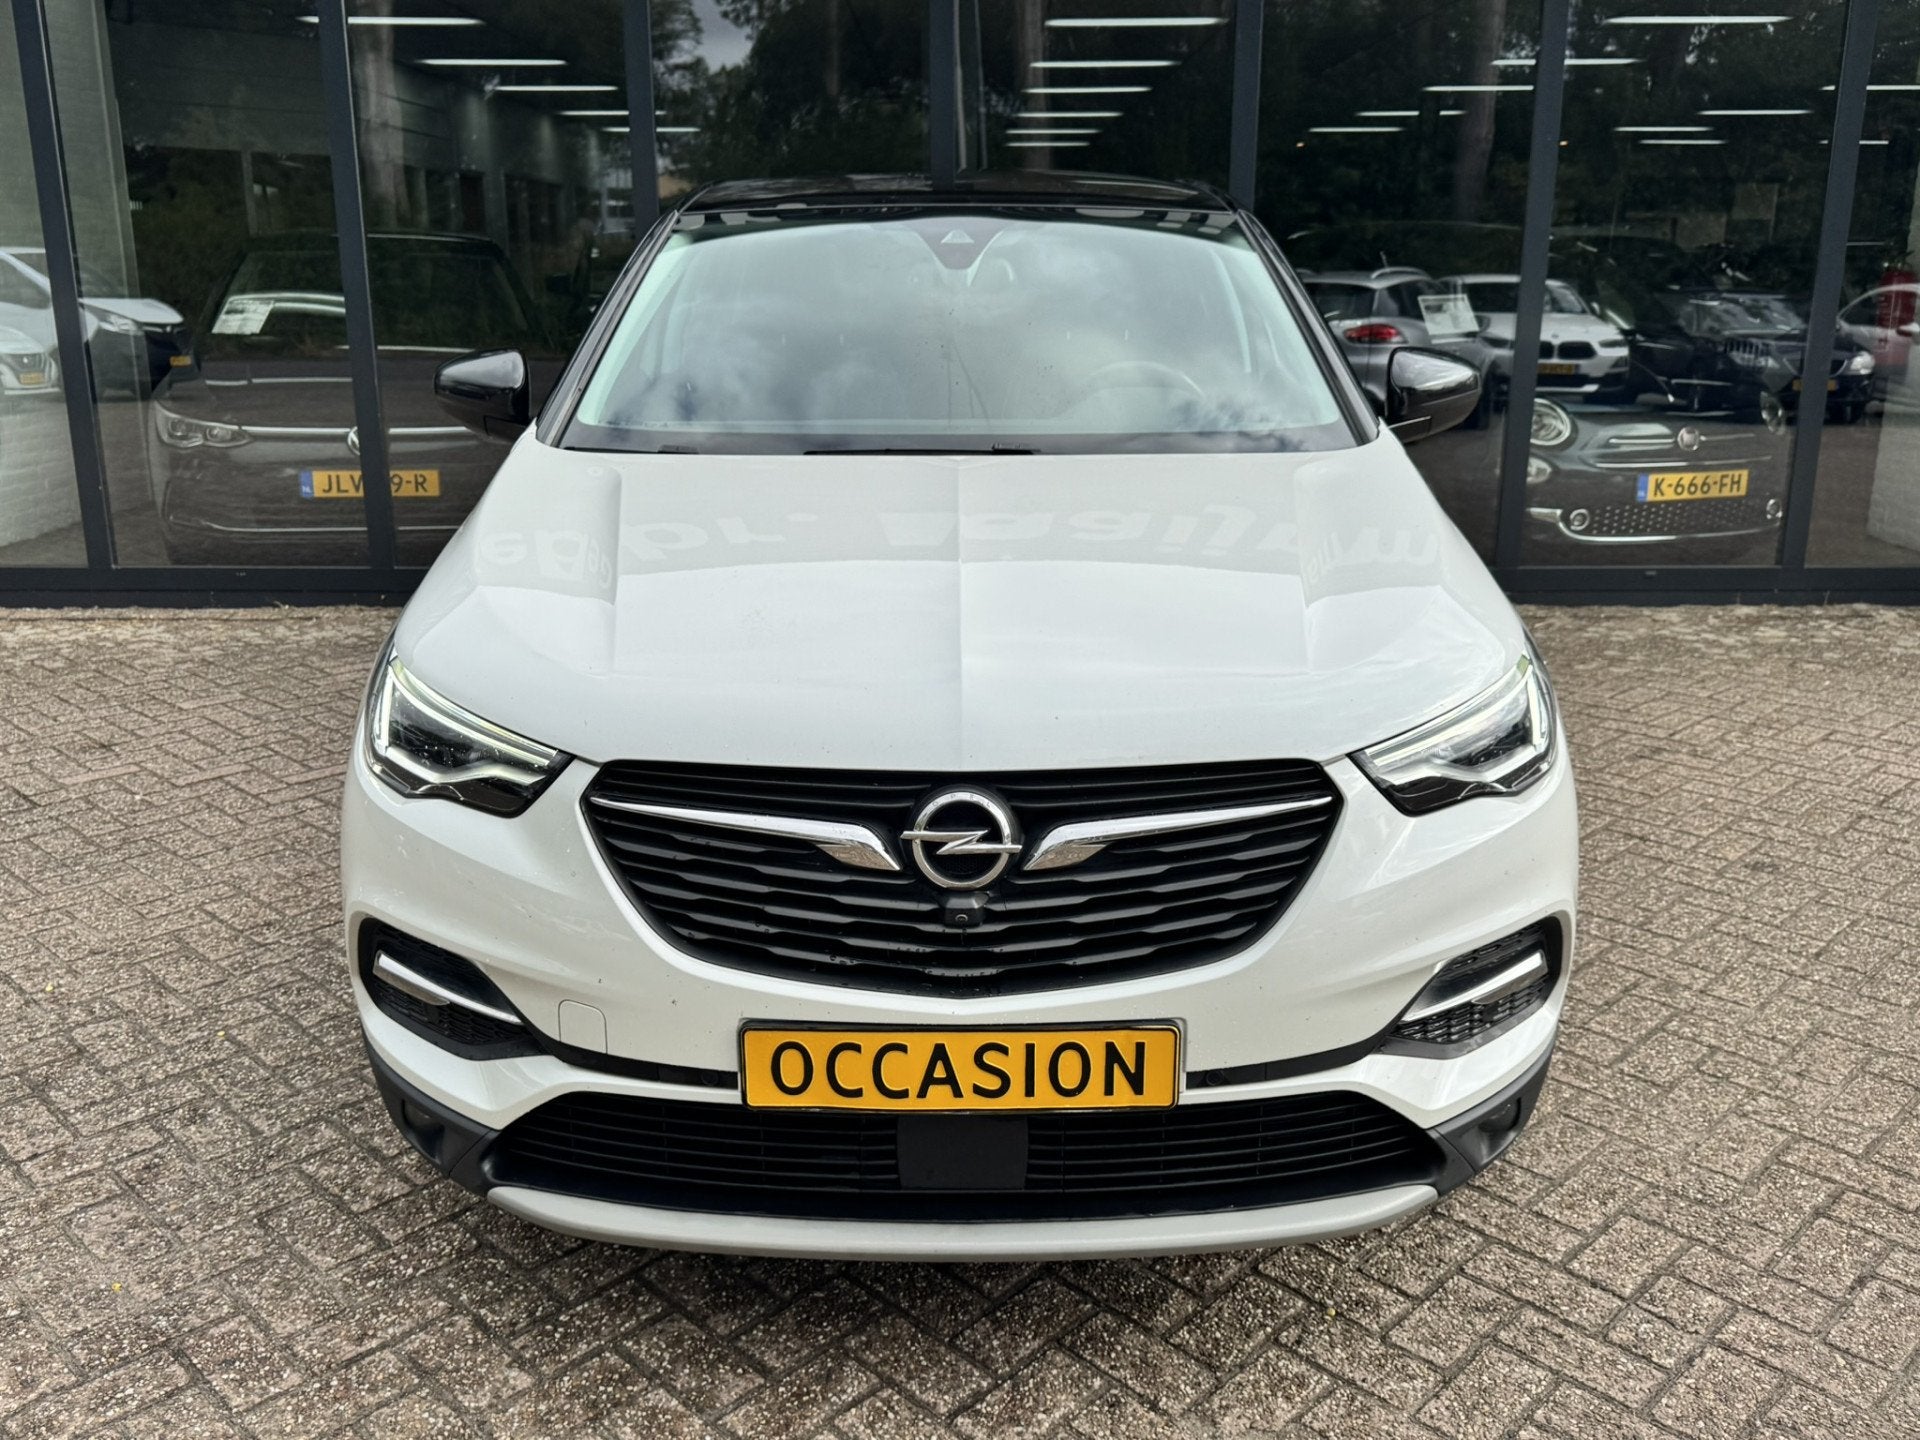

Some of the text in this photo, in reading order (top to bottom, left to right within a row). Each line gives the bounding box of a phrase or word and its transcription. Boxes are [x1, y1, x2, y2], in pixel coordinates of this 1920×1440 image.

[1653, 474, 1742, 497] K-666-FH
[931, 793, 992, 808] OPEL
[771, 1041, 1146, 1099] OCCASION
